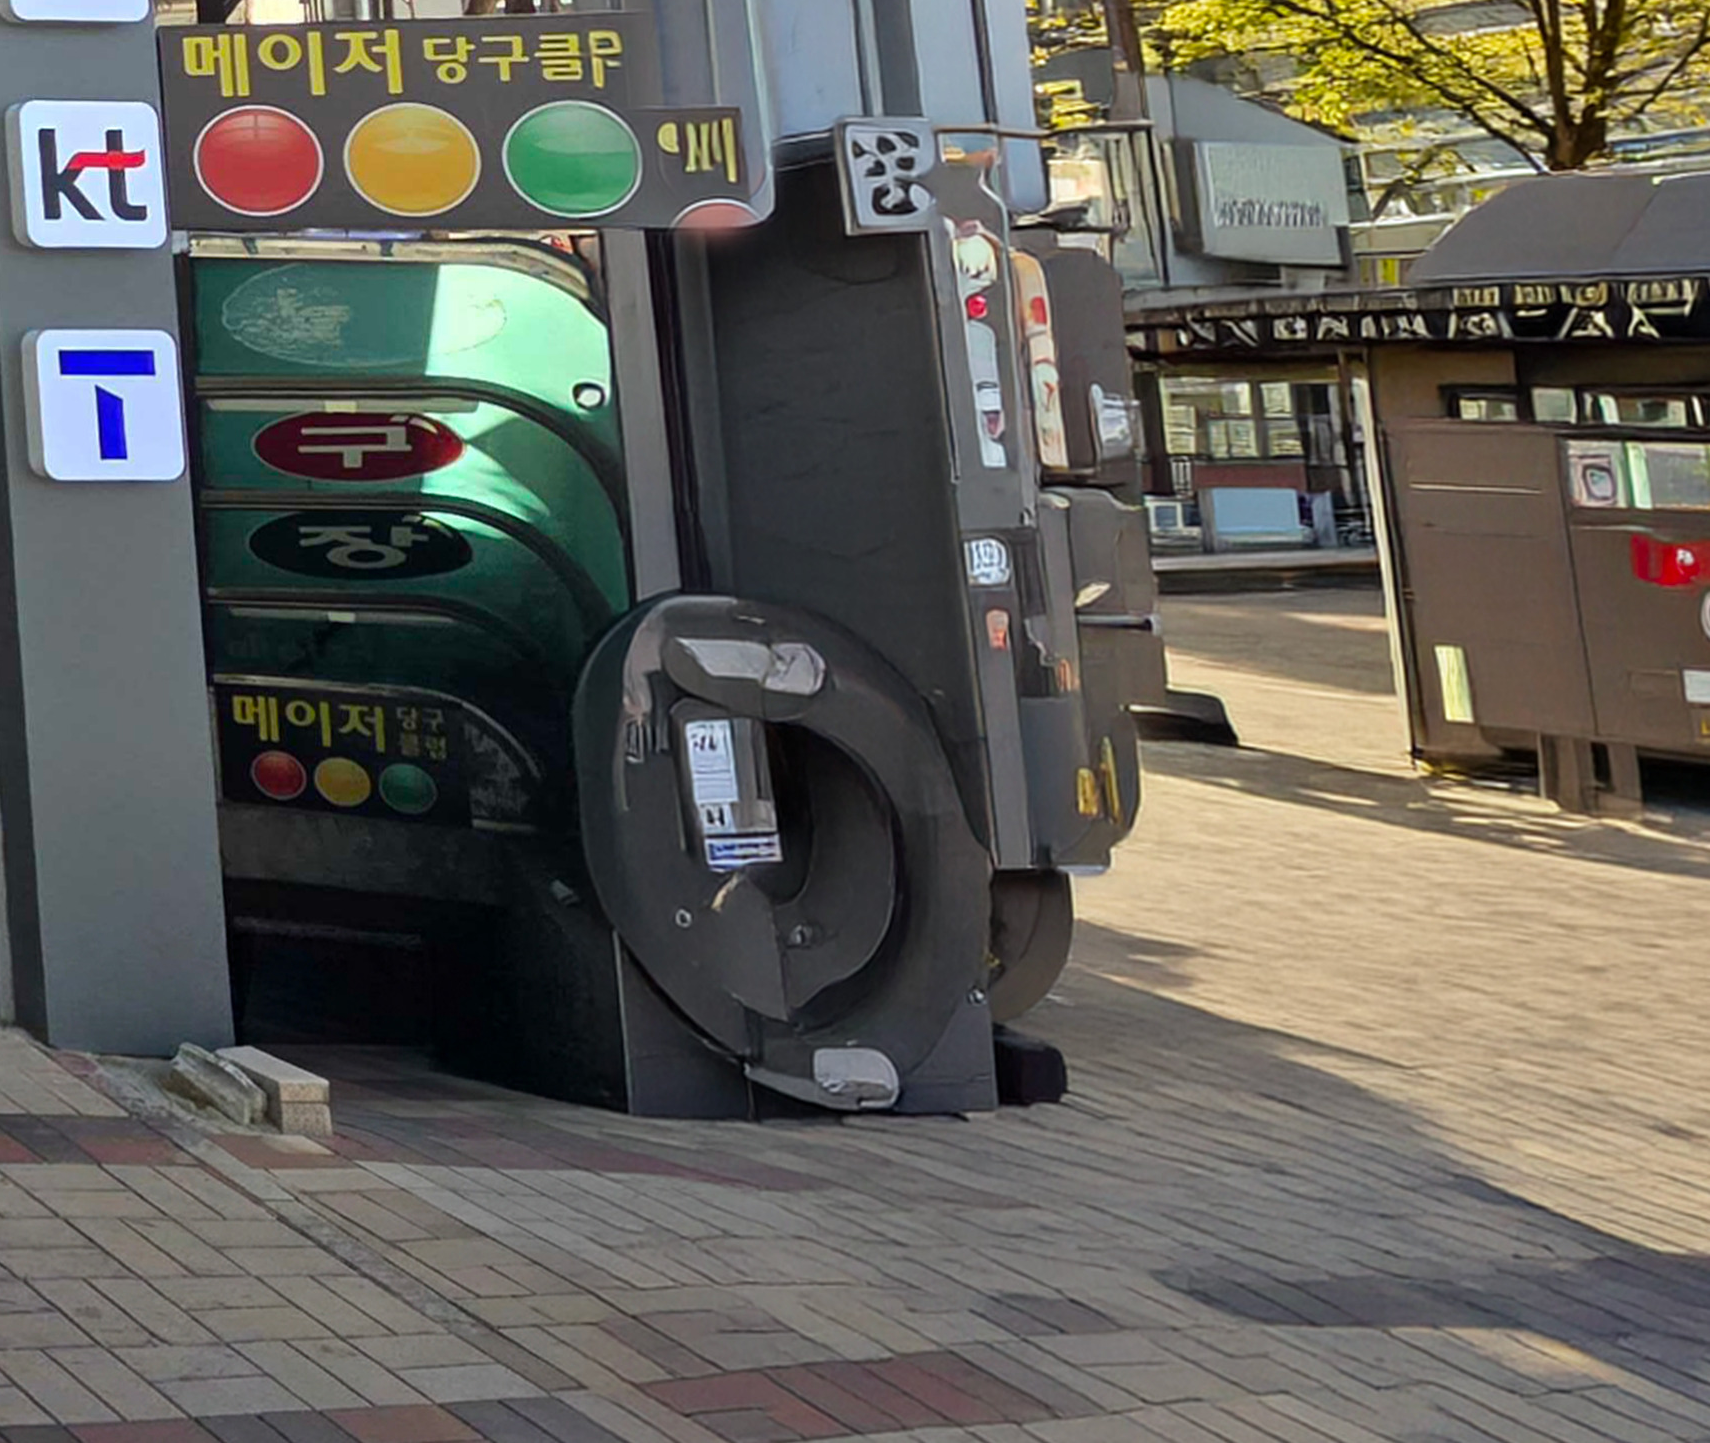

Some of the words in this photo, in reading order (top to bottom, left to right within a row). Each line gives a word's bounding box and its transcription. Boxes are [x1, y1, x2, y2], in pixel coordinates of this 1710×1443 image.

[182, 29, 403, 98] 메이저
[38, 127, 148, 221] kt
[232, 694, 386, 754] 메이저
